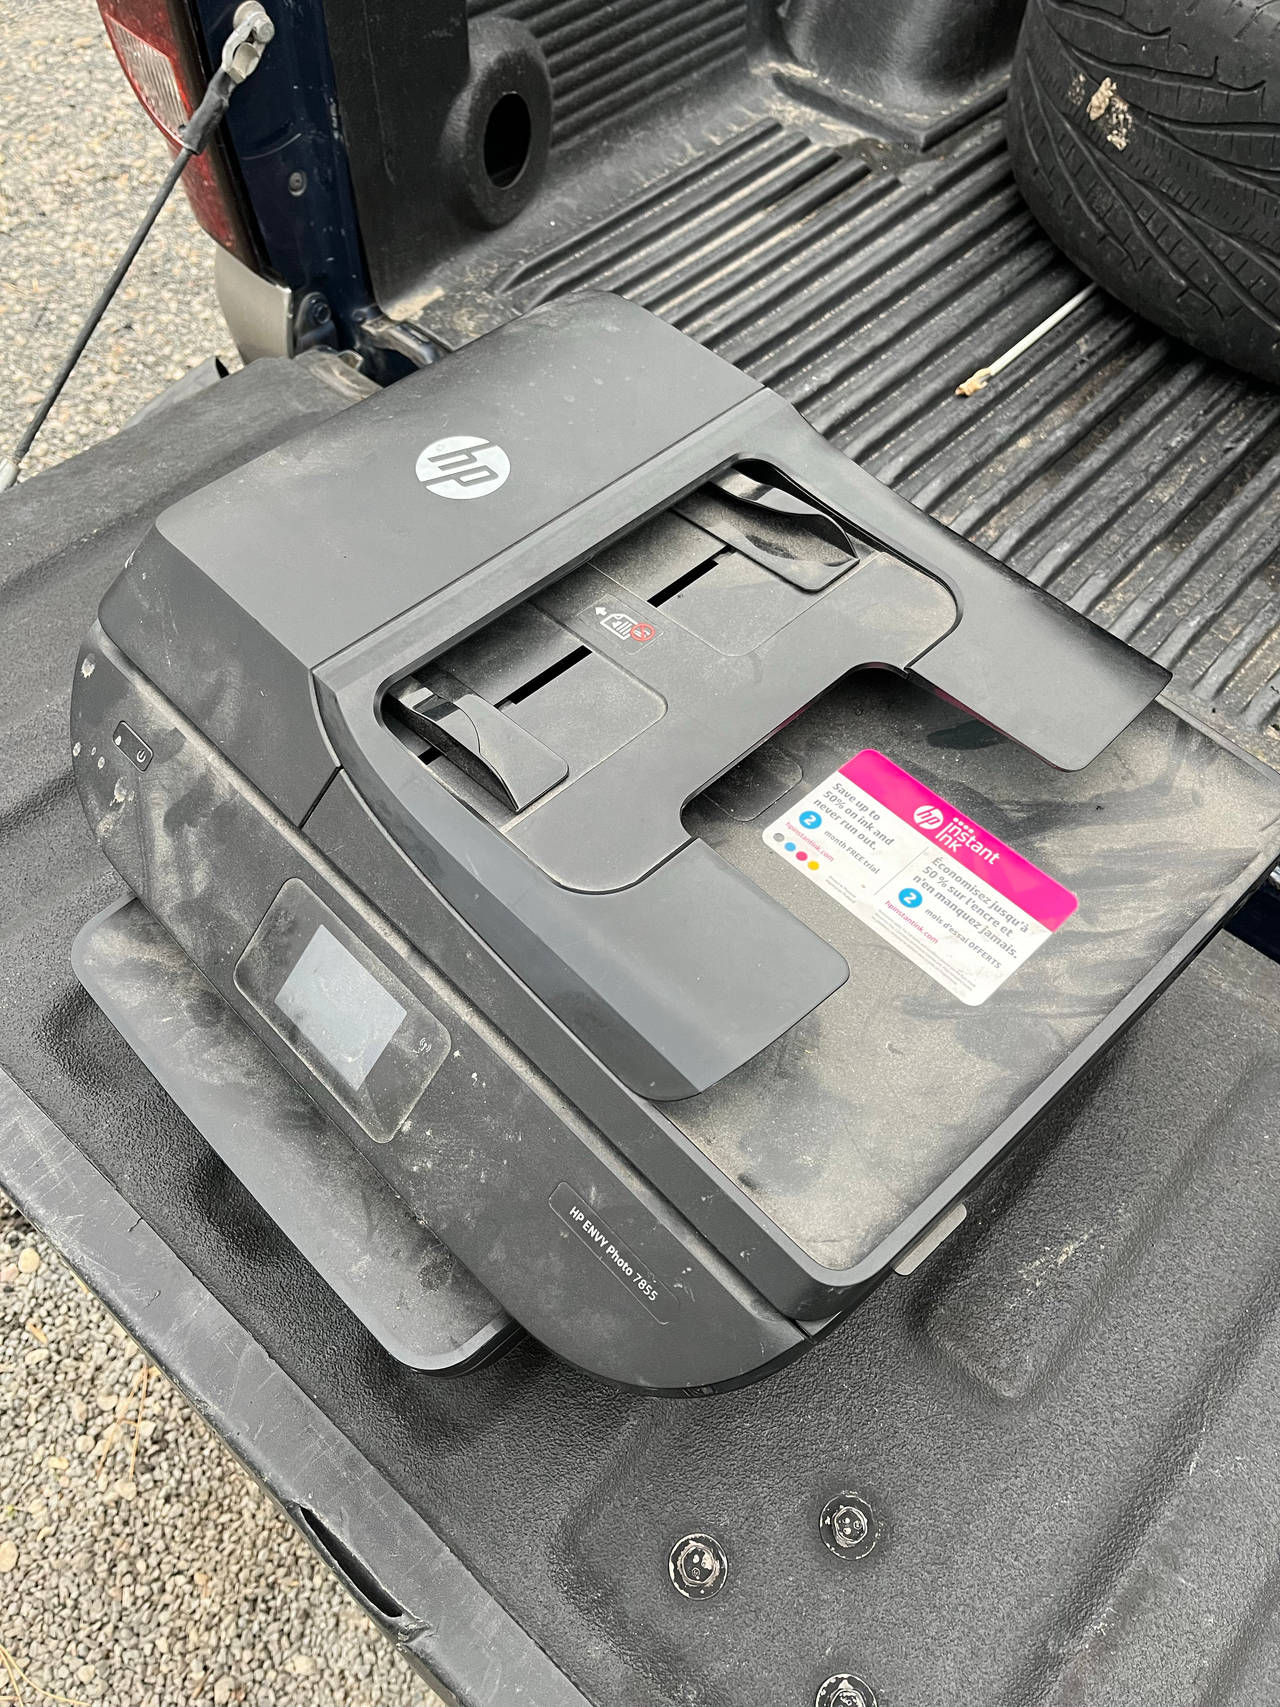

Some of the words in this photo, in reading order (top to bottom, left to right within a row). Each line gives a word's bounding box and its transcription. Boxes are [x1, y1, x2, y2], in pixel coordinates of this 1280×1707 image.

[416, 436, 510, 499] hp
[812, 799, 844, 822] never
[840, 820, 858, 834] run
[858, 834, 875, 850] out.
[823, 790, 847, 810] 50%
[845, 808, 858, 819] on
[858, 816, 874, 831] ink
[873, 830, 894, 845] and
[832, 783, 856, 802] Save
[856, 801, 869, 812] up
[869, 810, 880, 820] to
[913, 805, 943, 829] hp
[824, 831, 846, 848] month
[846, 847, 864, 862] FREE
[863, 861, 880, 874] trial
[922, 865, 940, 880] 50
[937, 876, 949, 888] %
[947, 886, 966, 900] sur
[1000, 926, 1013, 937] et
[931, 858, 991, 904] Économisez
[925, 909, 943, 924] mois
[968, 942, 1001, 968] OFFERTS
[934, 892, 982, 929] manquez
[978, 925, 1016, 958] jamais.
[569, 1206, 585, 1221] HP
[582, 1220, 608, 1247] ENVY
[605, 1245, 633, 1276] Photo
[632, 1273, 658, 1301] 7855
